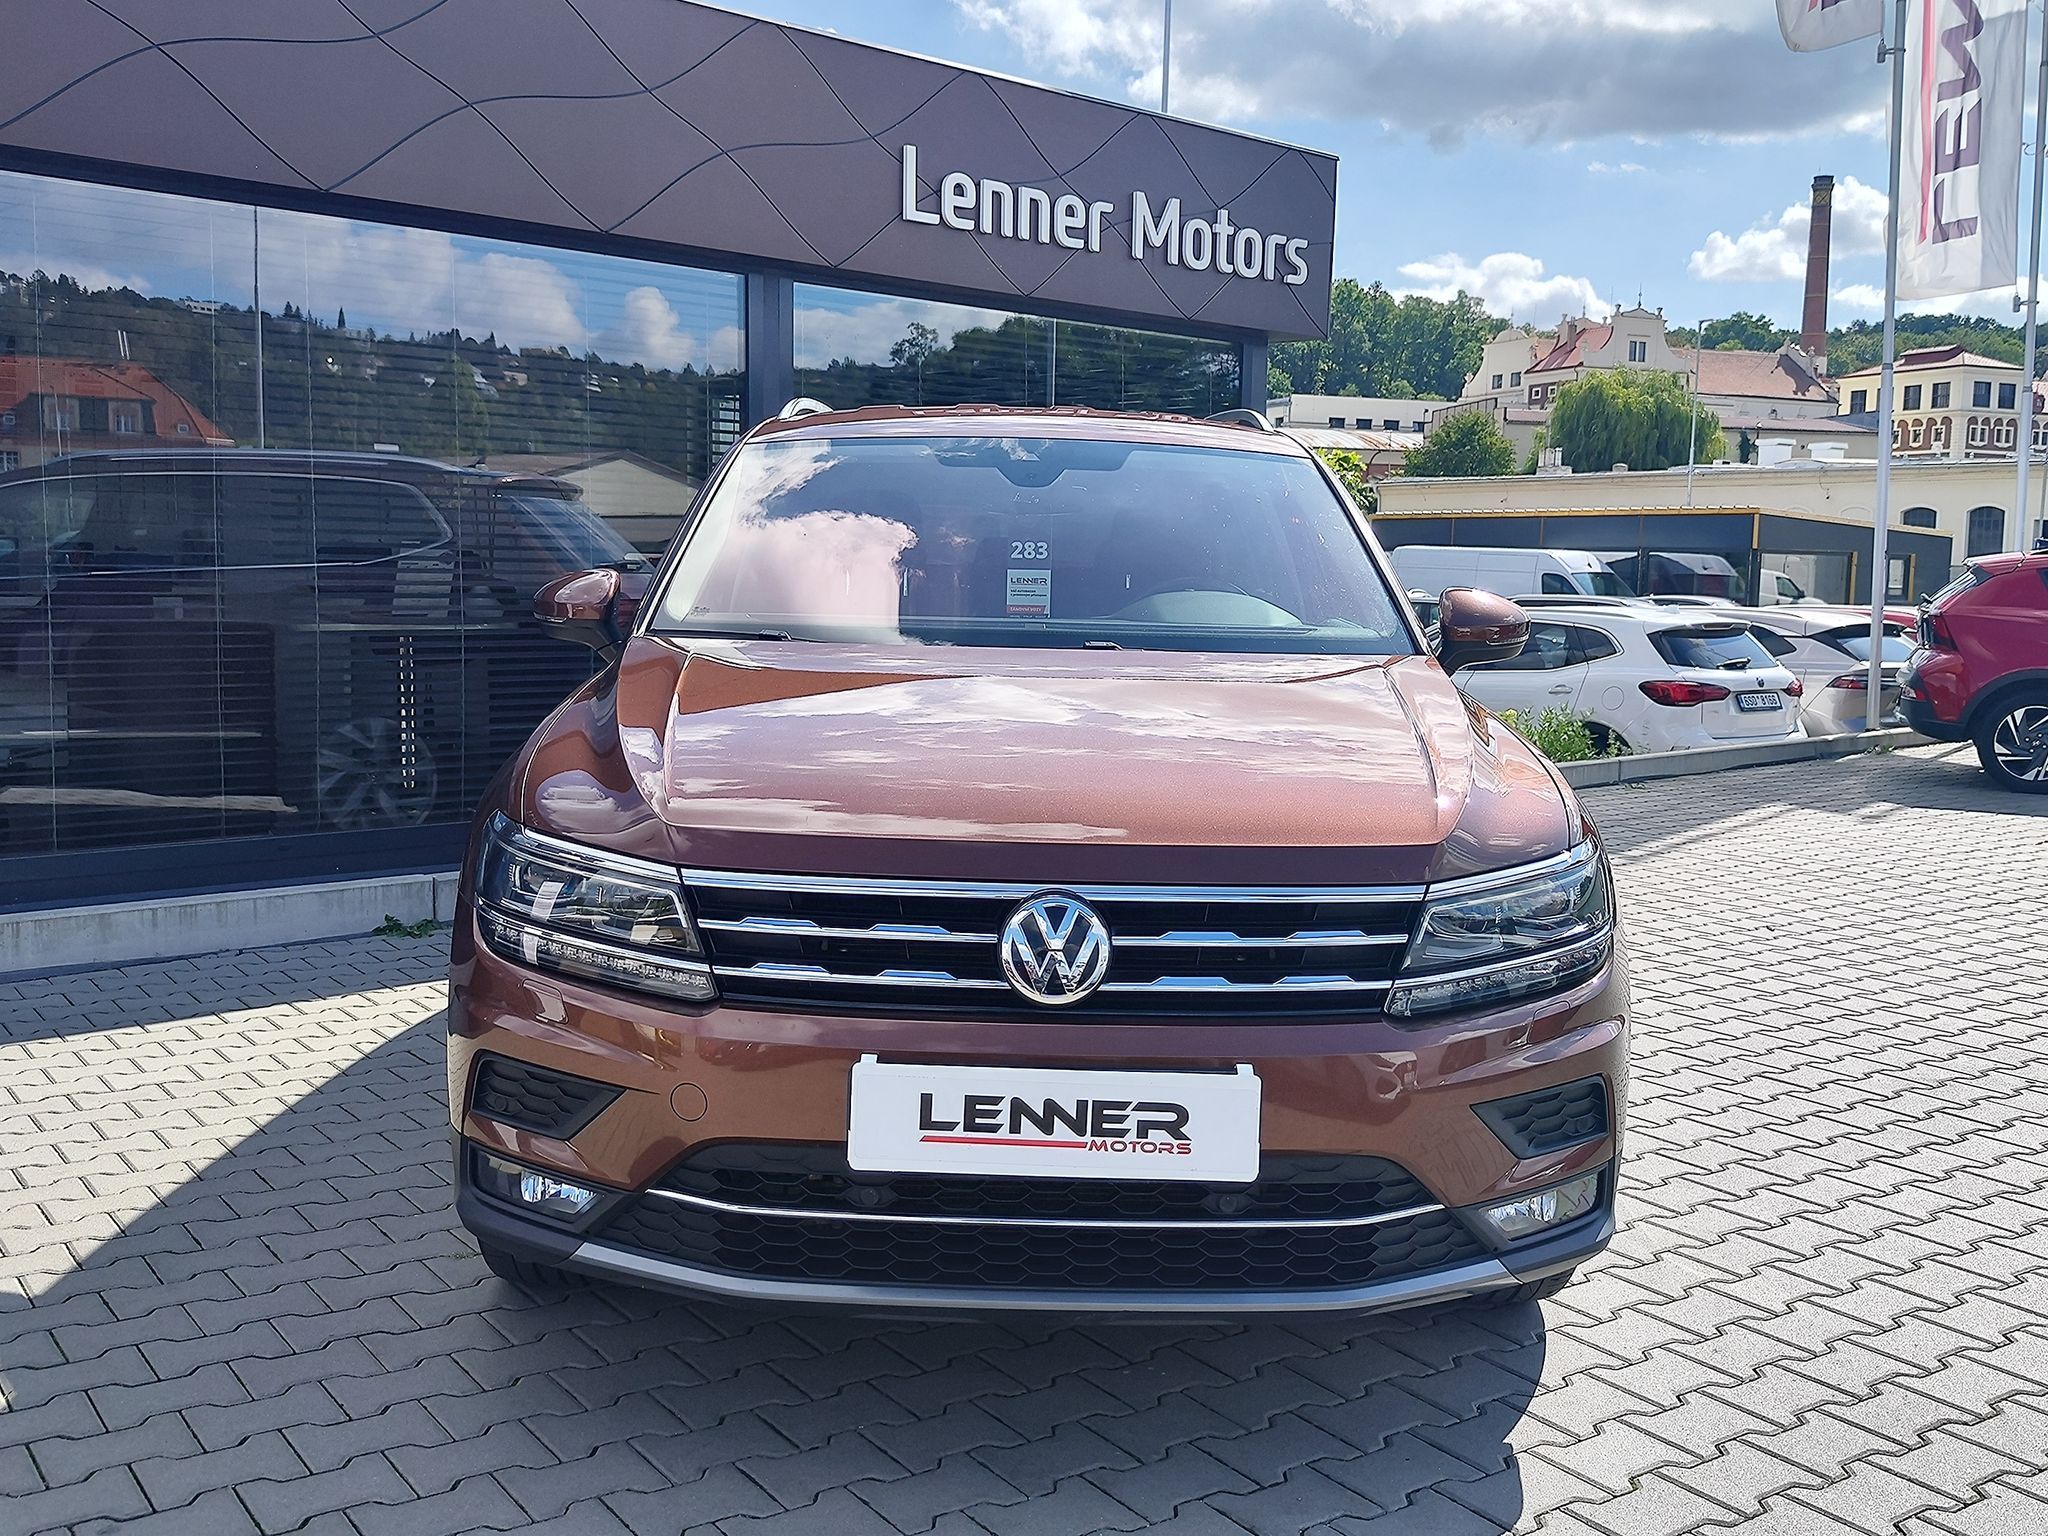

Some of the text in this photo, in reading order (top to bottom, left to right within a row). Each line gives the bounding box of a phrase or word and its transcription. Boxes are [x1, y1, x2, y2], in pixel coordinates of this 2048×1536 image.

[902, 144, 1309, 285] Lenner Motors
[1010, 541, 1048, 559] 283
[919, 1092, 1192, 1141] LENNER
[1088, 1140, 1192, 1155] MOTORS
